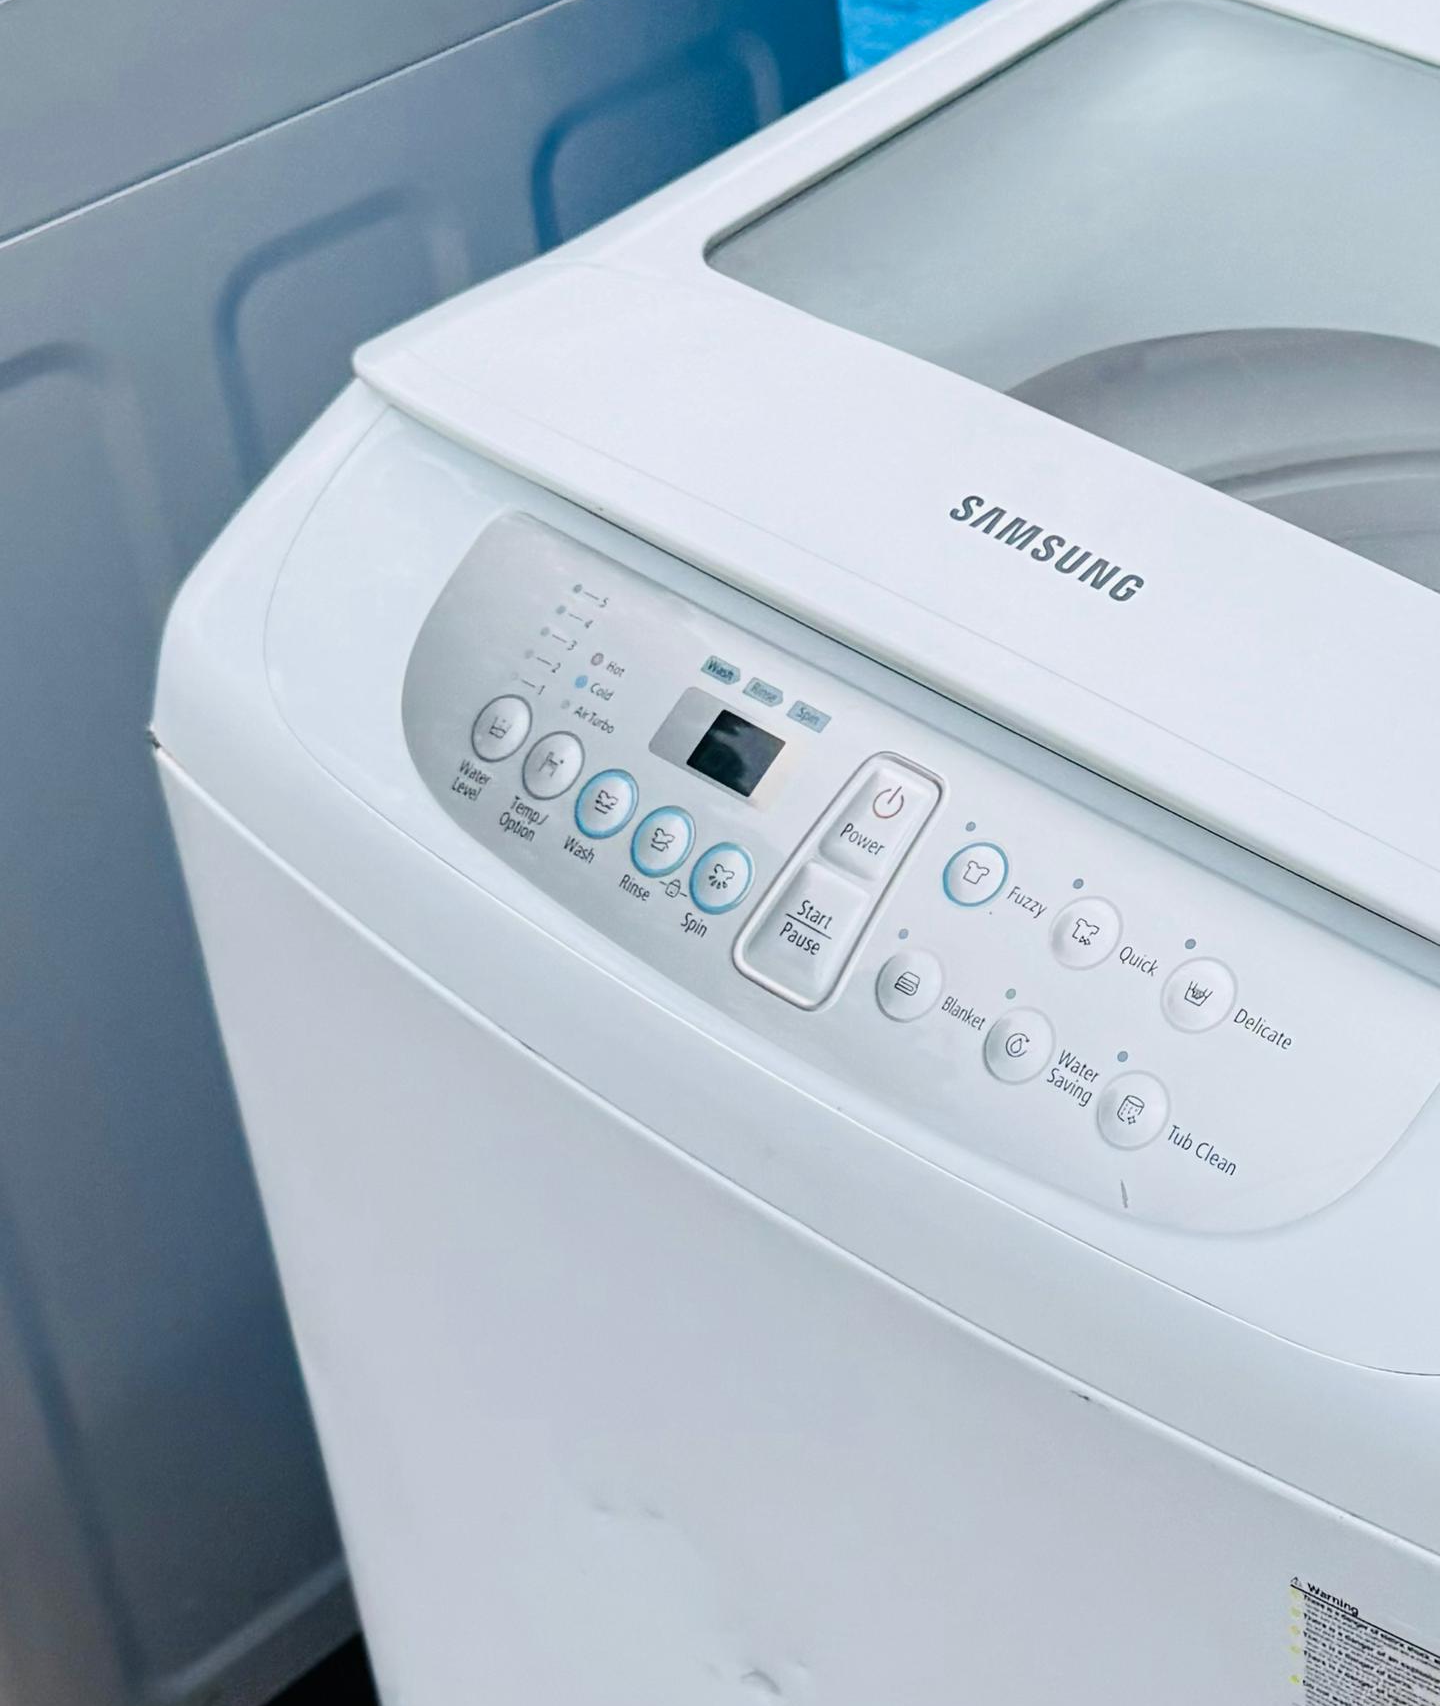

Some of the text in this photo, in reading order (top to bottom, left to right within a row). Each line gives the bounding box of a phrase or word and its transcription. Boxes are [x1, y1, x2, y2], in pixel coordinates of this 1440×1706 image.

[949, 495, 1145, 602] SAMSUNG
[600, 597, 609, 608] 5
[567, 640, 578, 651] 3
[551, 662, 561, 673] 2
[606, 660, 626, 678] Hot
[590, 682, 615, 701] Cold
[458, 759, 492, 786] Water
[451, 777, 483, 802] Level
[499, 811, 536, 843] Option
[840, 822, 885, 856] Power
[563, 835, 596, 865] Wash
[618, 873, 652, 903] Rinse
[1006, 886, 1048, 920] Fuzzy
[680, 912, 708, 938] Spin
[796, 899, 834, 930] Start
[779, 921, 821, 956] Pause
[1118, 945, 1159, 977] Quick
[941, 995, 987, 1032] Blanket
[1233, 1008, 1293, 1051] Delicate
[1057, 1049, 1101, 1084] Water
[1046, 1067, 1093, 1108] Saving
[1167, 1124, 1237, 1177] Tub Clean
[1307, 1581, 1359, 1618] Warning
